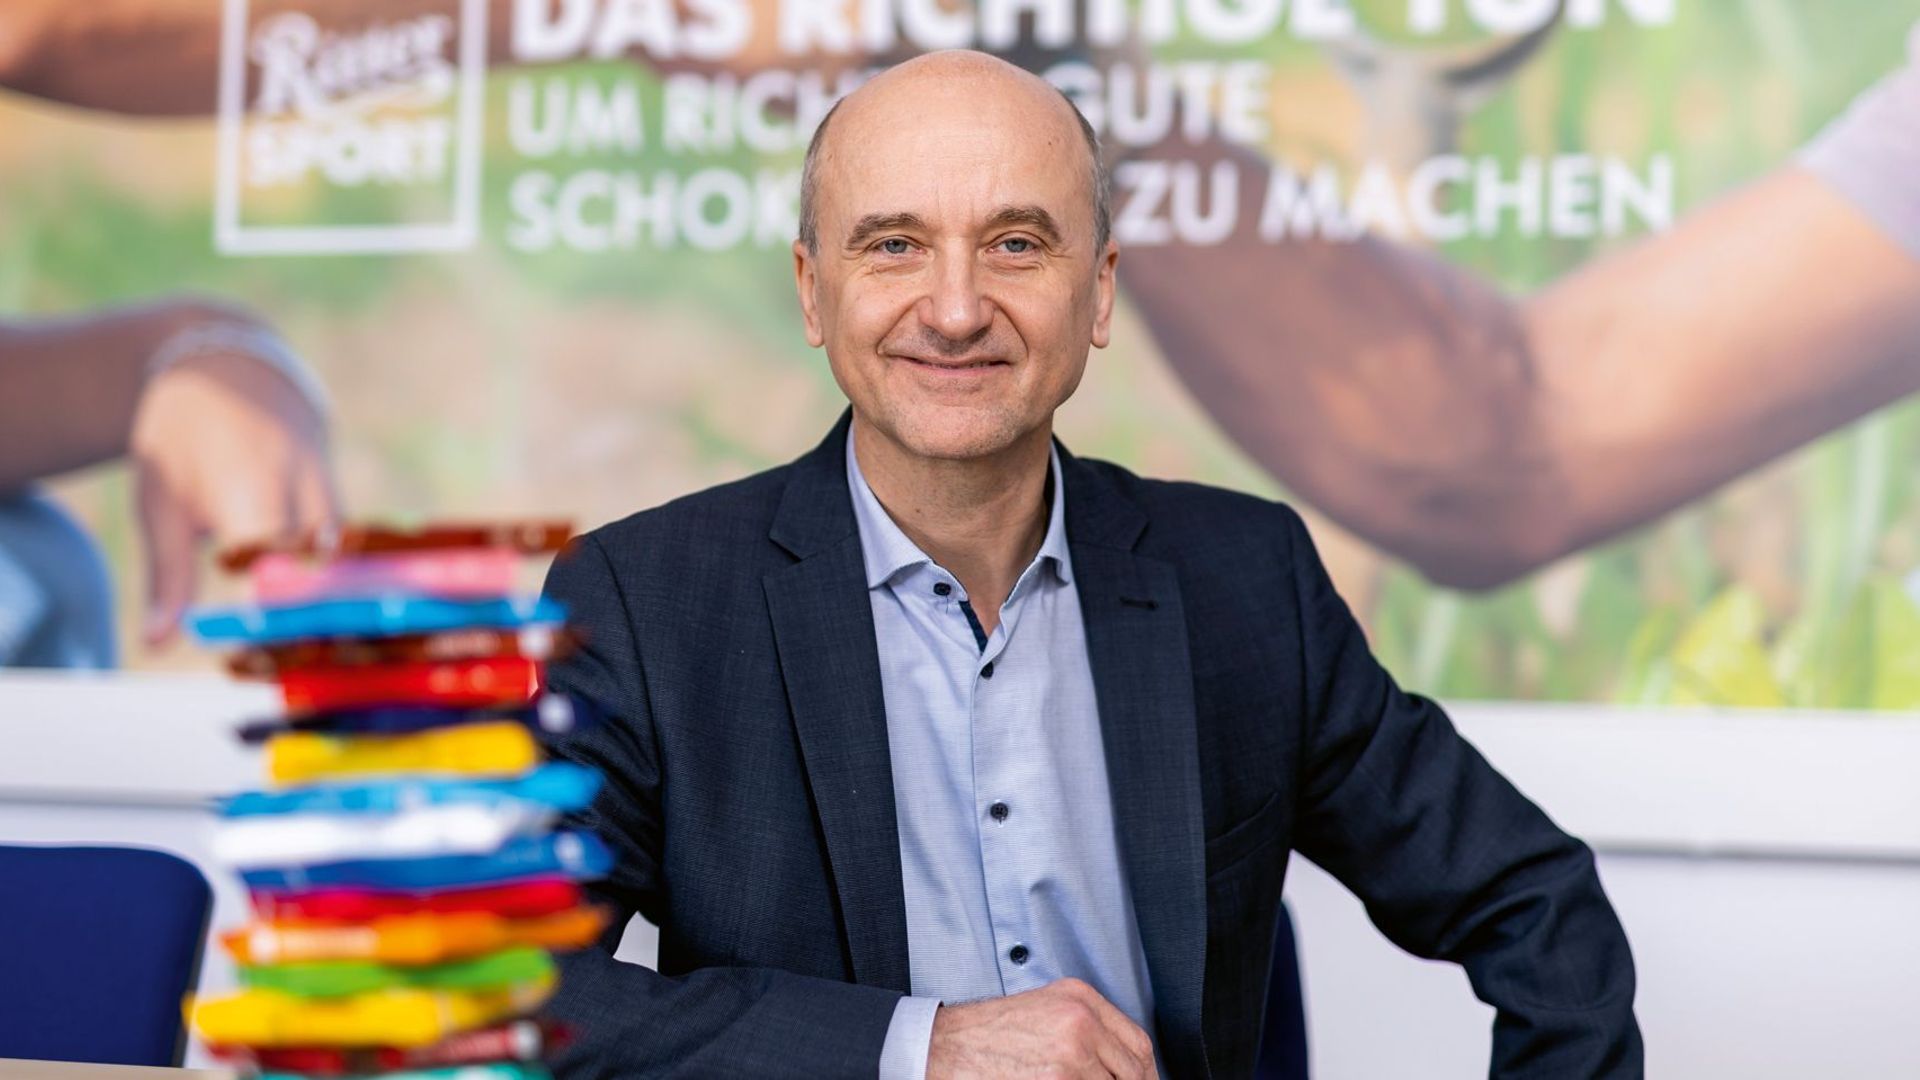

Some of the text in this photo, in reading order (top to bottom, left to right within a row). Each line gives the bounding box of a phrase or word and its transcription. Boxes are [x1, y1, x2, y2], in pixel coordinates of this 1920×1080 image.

[510, 0, 755, 61] DAS
[508, 75, 645, 157] UM
[662, 68, 885, 155] RICH
[507, 154, 1674, 254] SCHOK ZU MACHEN
